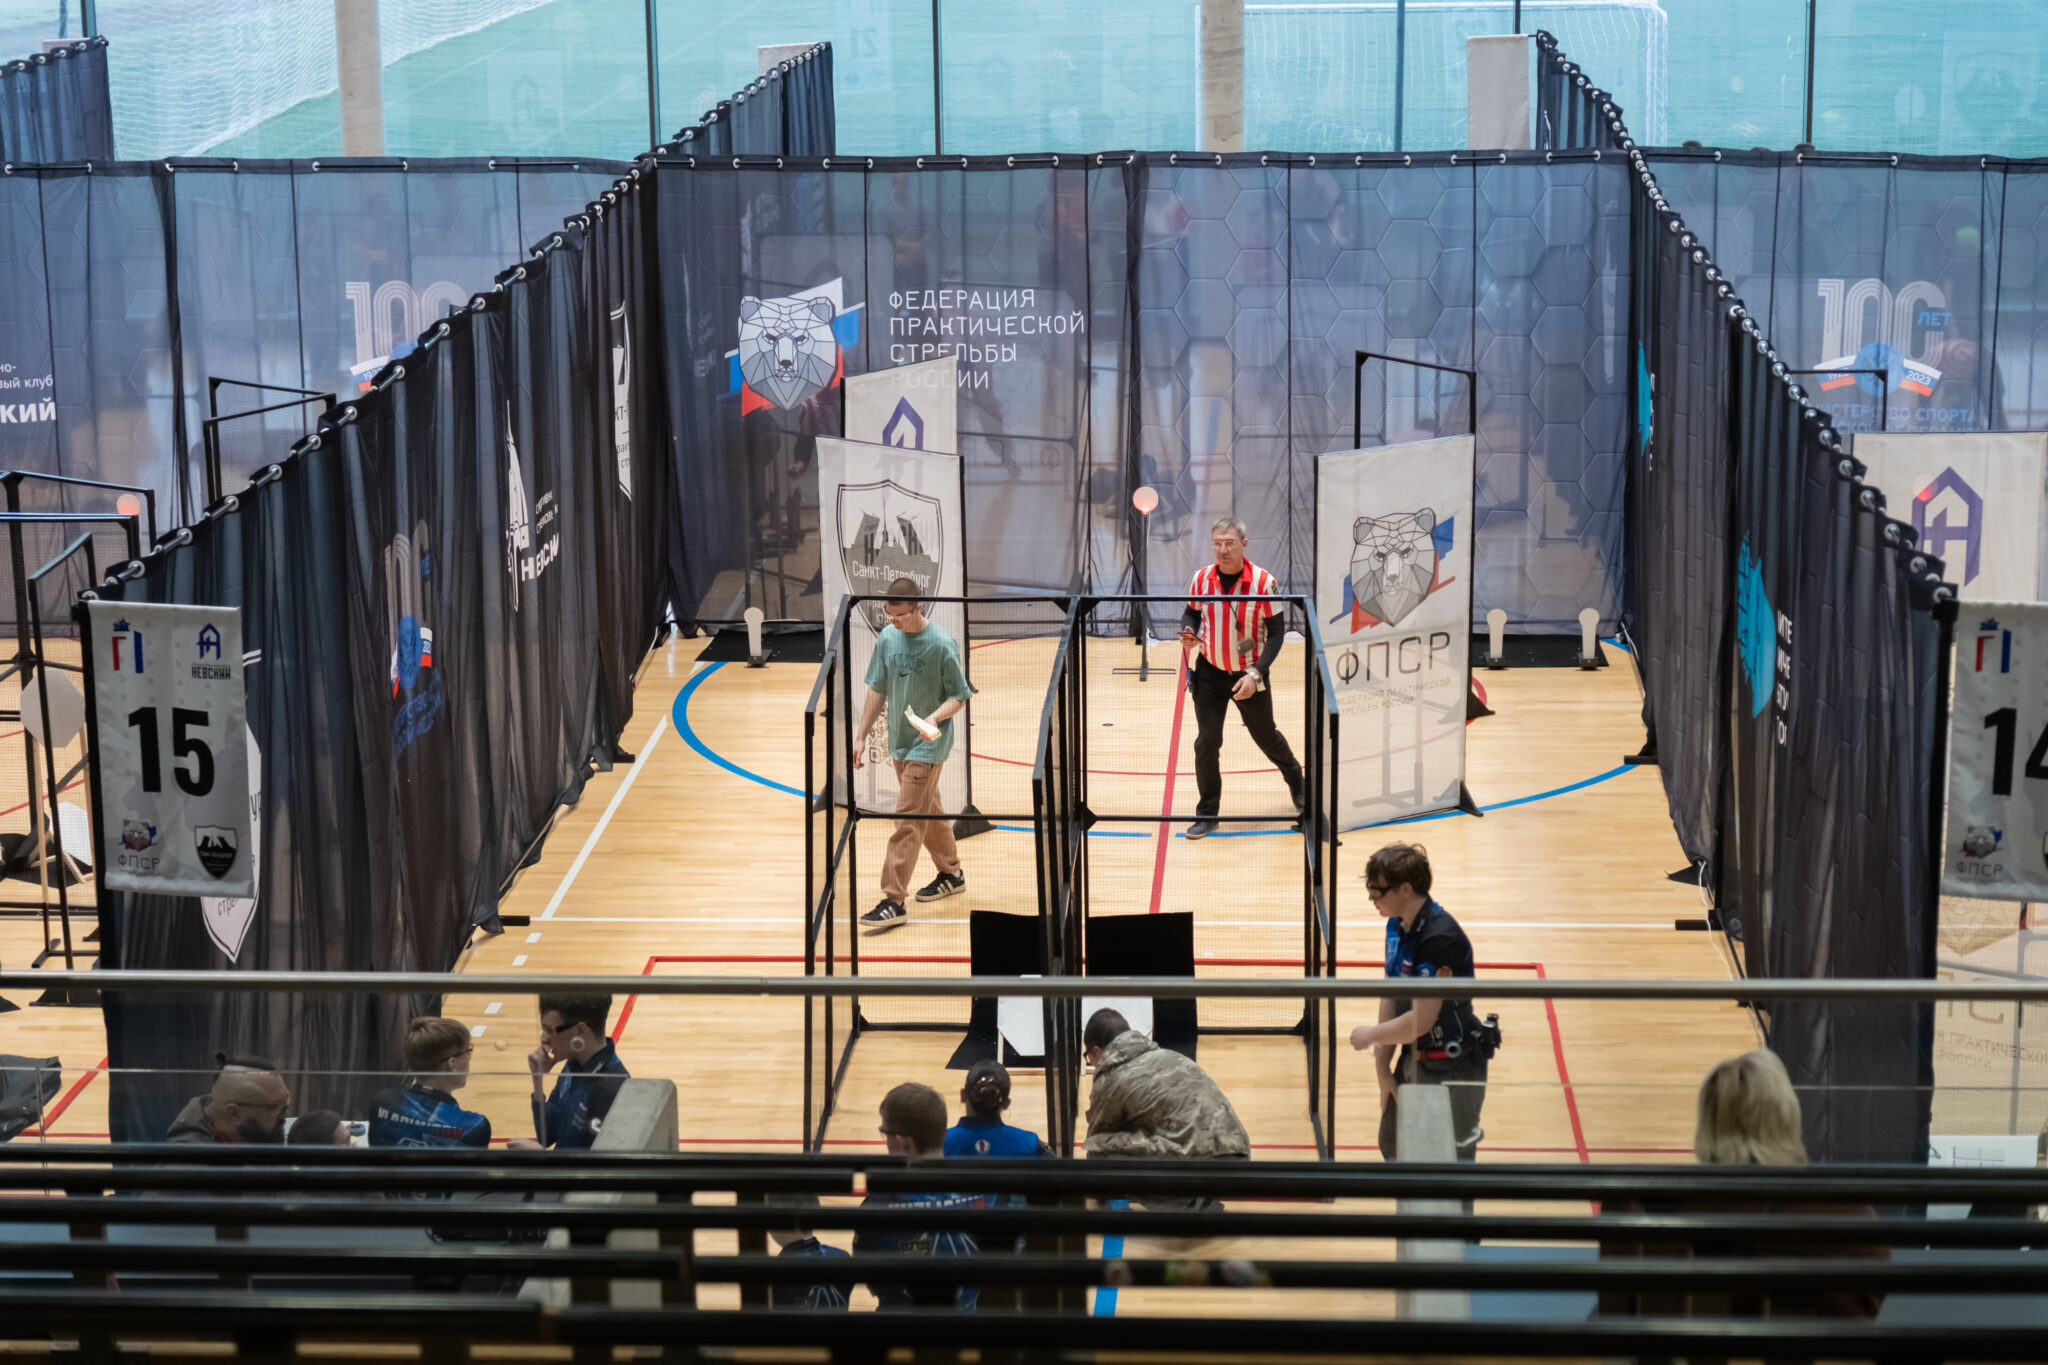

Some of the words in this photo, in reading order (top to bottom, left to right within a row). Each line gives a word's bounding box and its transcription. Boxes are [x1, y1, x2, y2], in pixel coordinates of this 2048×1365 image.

[889, 289, 1035, 312] ФЕДЕРАЦИЯ
[890, 310, 1085, 337] ПРАКТИЧЕСКОЙ
[1917, 311, 1952, 327] ЛЕТ
[890, 343, 1018, 363] СТРЕЛЬБЫ
[24, 374, 54, 390] клуб
[1906, 369, 1932, 386] 2023
[0, 396, 57, 424] КИЙ
[1336, 631, 1451, 685] ФПСР
[128, 706, 215, 797] 15
[118, 854, 161, 871] ФПСР
[1956, 861, 2004, 878] ФПСР
